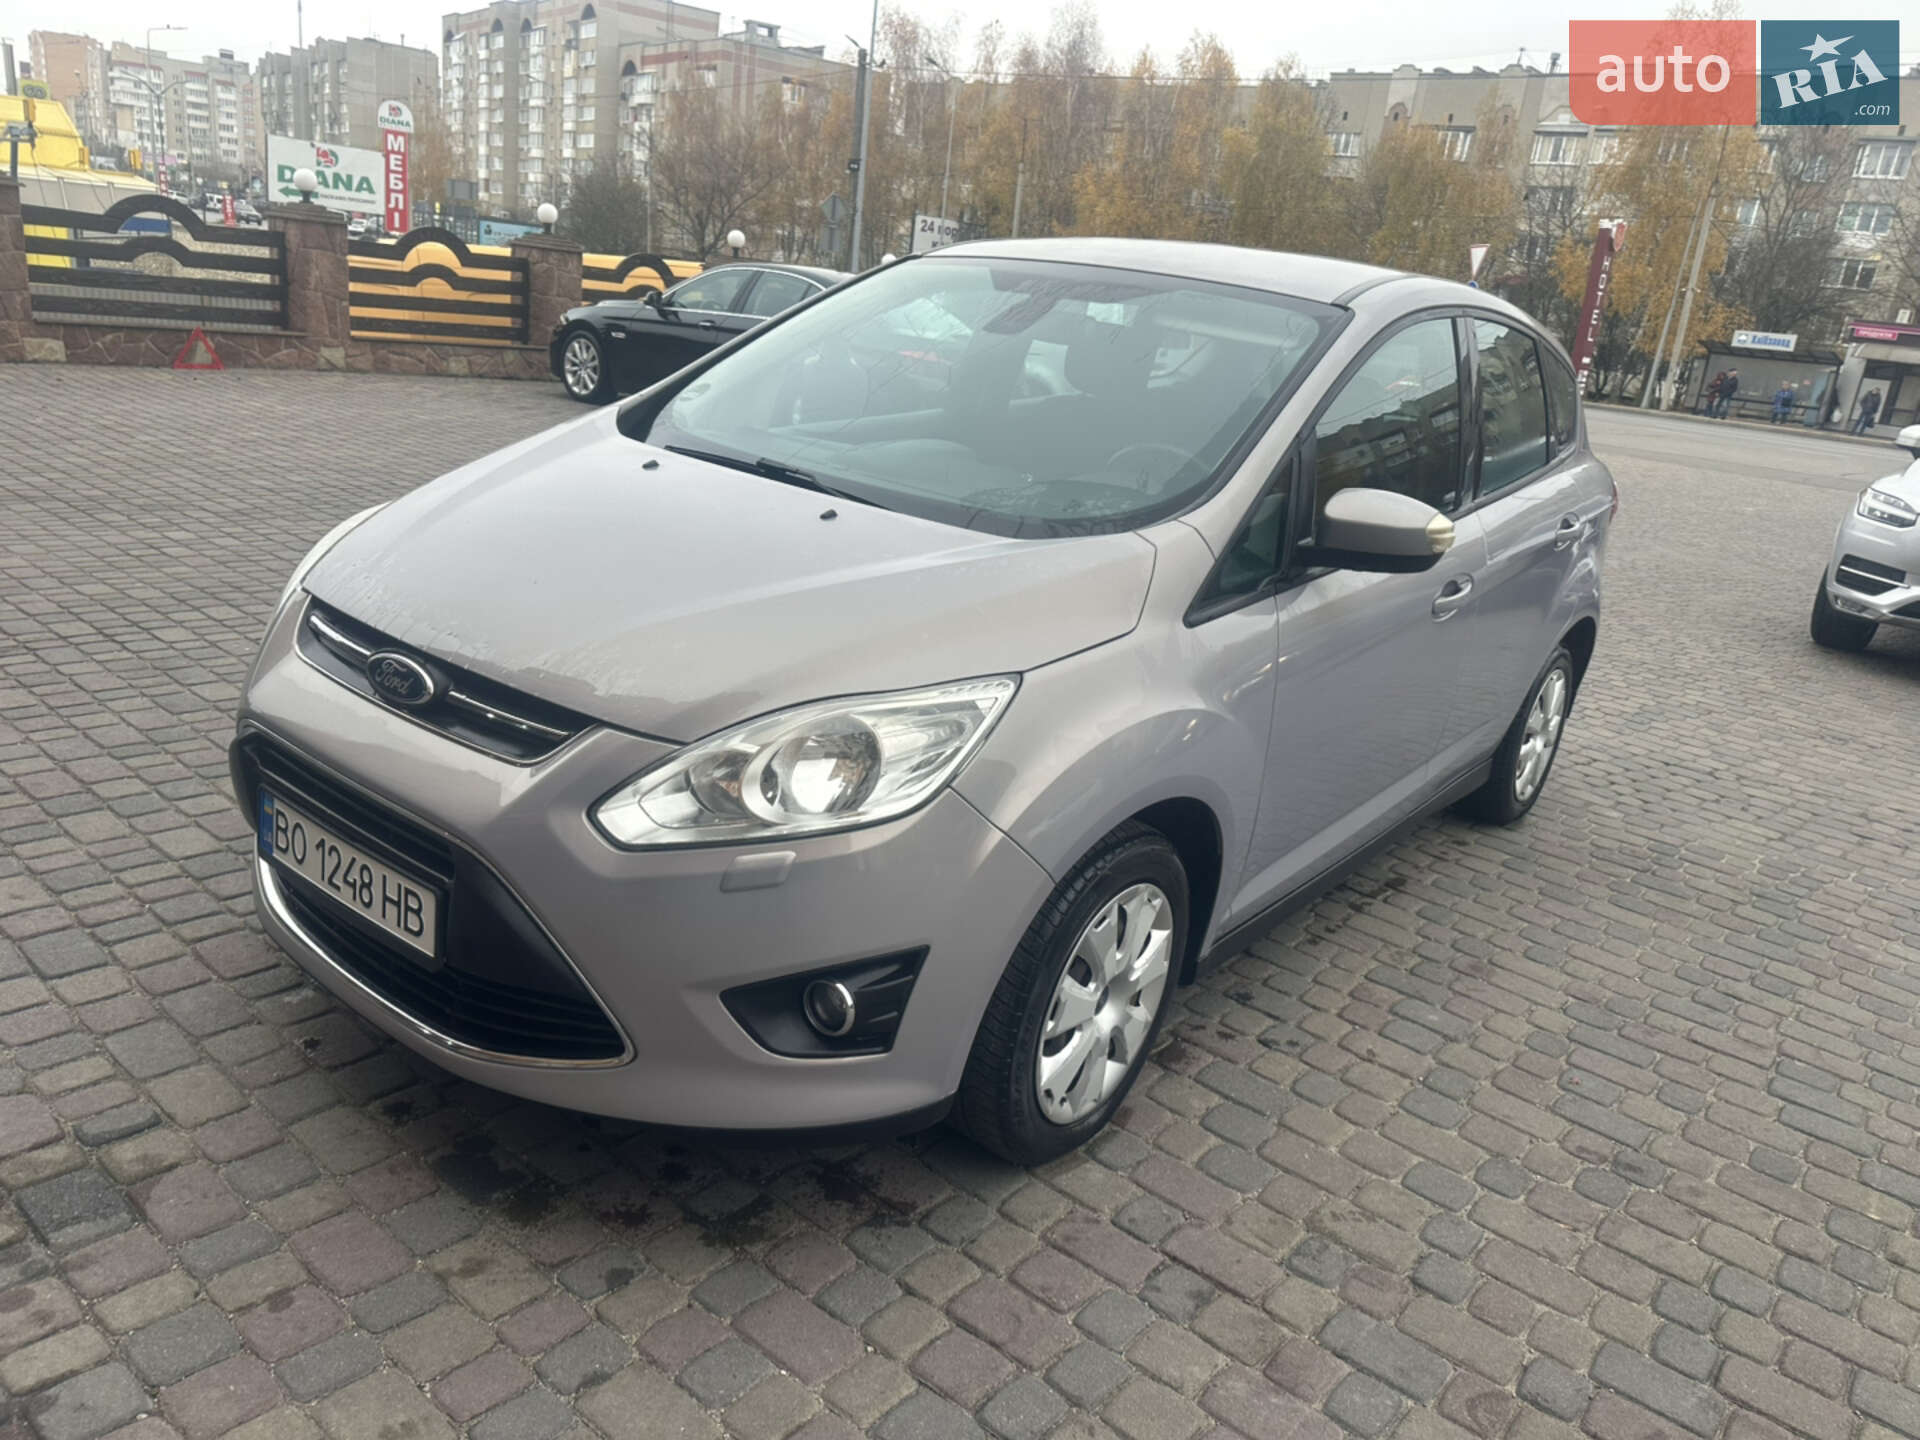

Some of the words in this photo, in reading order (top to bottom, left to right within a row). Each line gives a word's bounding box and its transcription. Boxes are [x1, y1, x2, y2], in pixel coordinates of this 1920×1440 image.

[379, 116, 411, 128] DIANA
[277, 164, 376, 195] DANA
[386, 133, 405, 229] МЕБЛІ
[920, 219, 935, 233] 24
[1587, 256, 1611, 342] HOTEL
[376, 660, 415, 694] Ford
[275, 808, 307, 865] BO
[315, 838, 374, 909] 1248
[382, 874, 425, 937] HB
